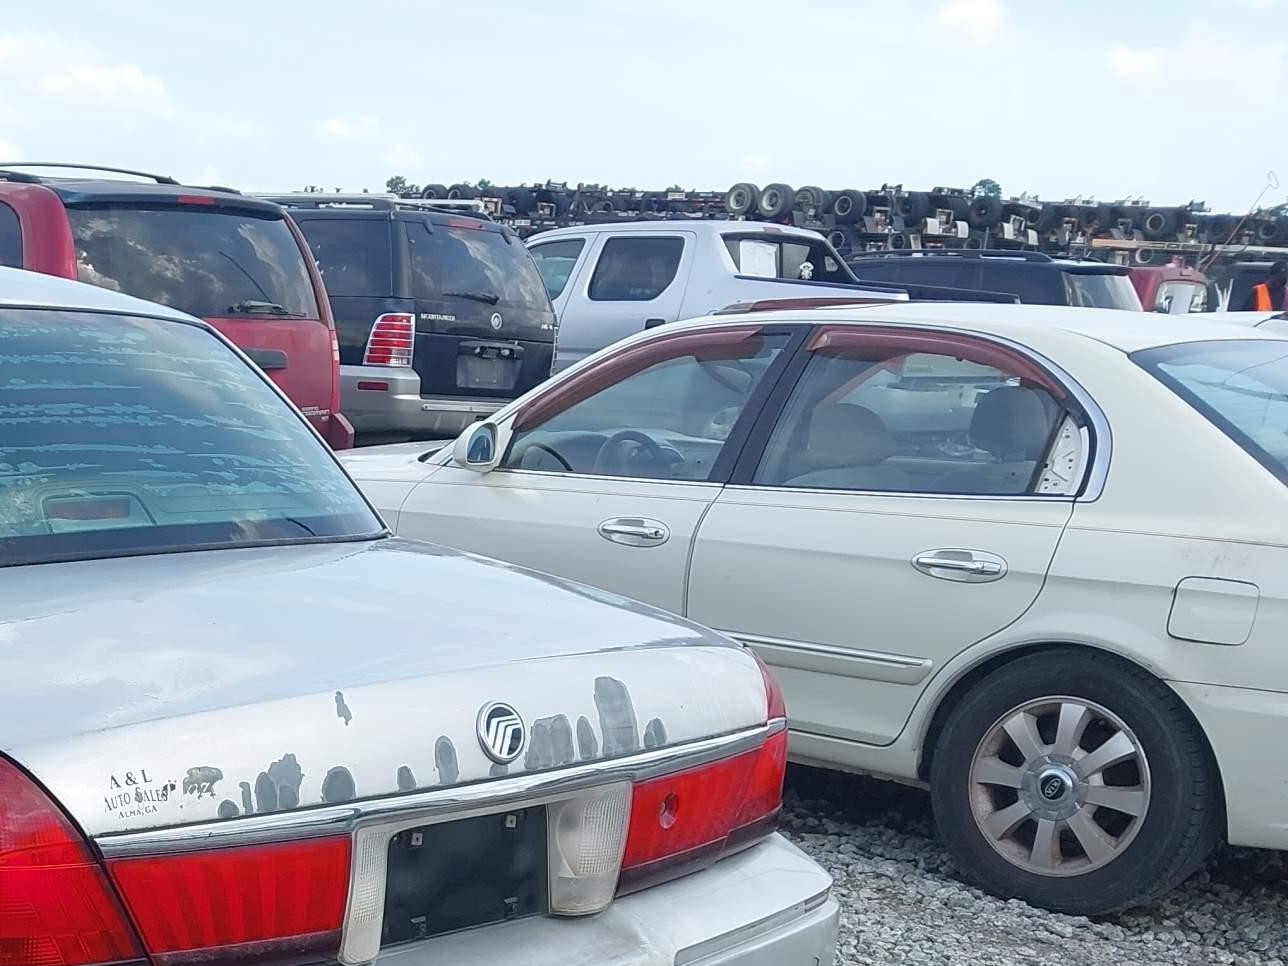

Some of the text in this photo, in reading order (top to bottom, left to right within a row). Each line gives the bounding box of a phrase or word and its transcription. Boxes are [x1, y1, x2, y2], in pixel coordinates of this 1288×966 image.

[109, 769, 153, 790] A & L
[104, 786, 168, 812] AUTO SALES
